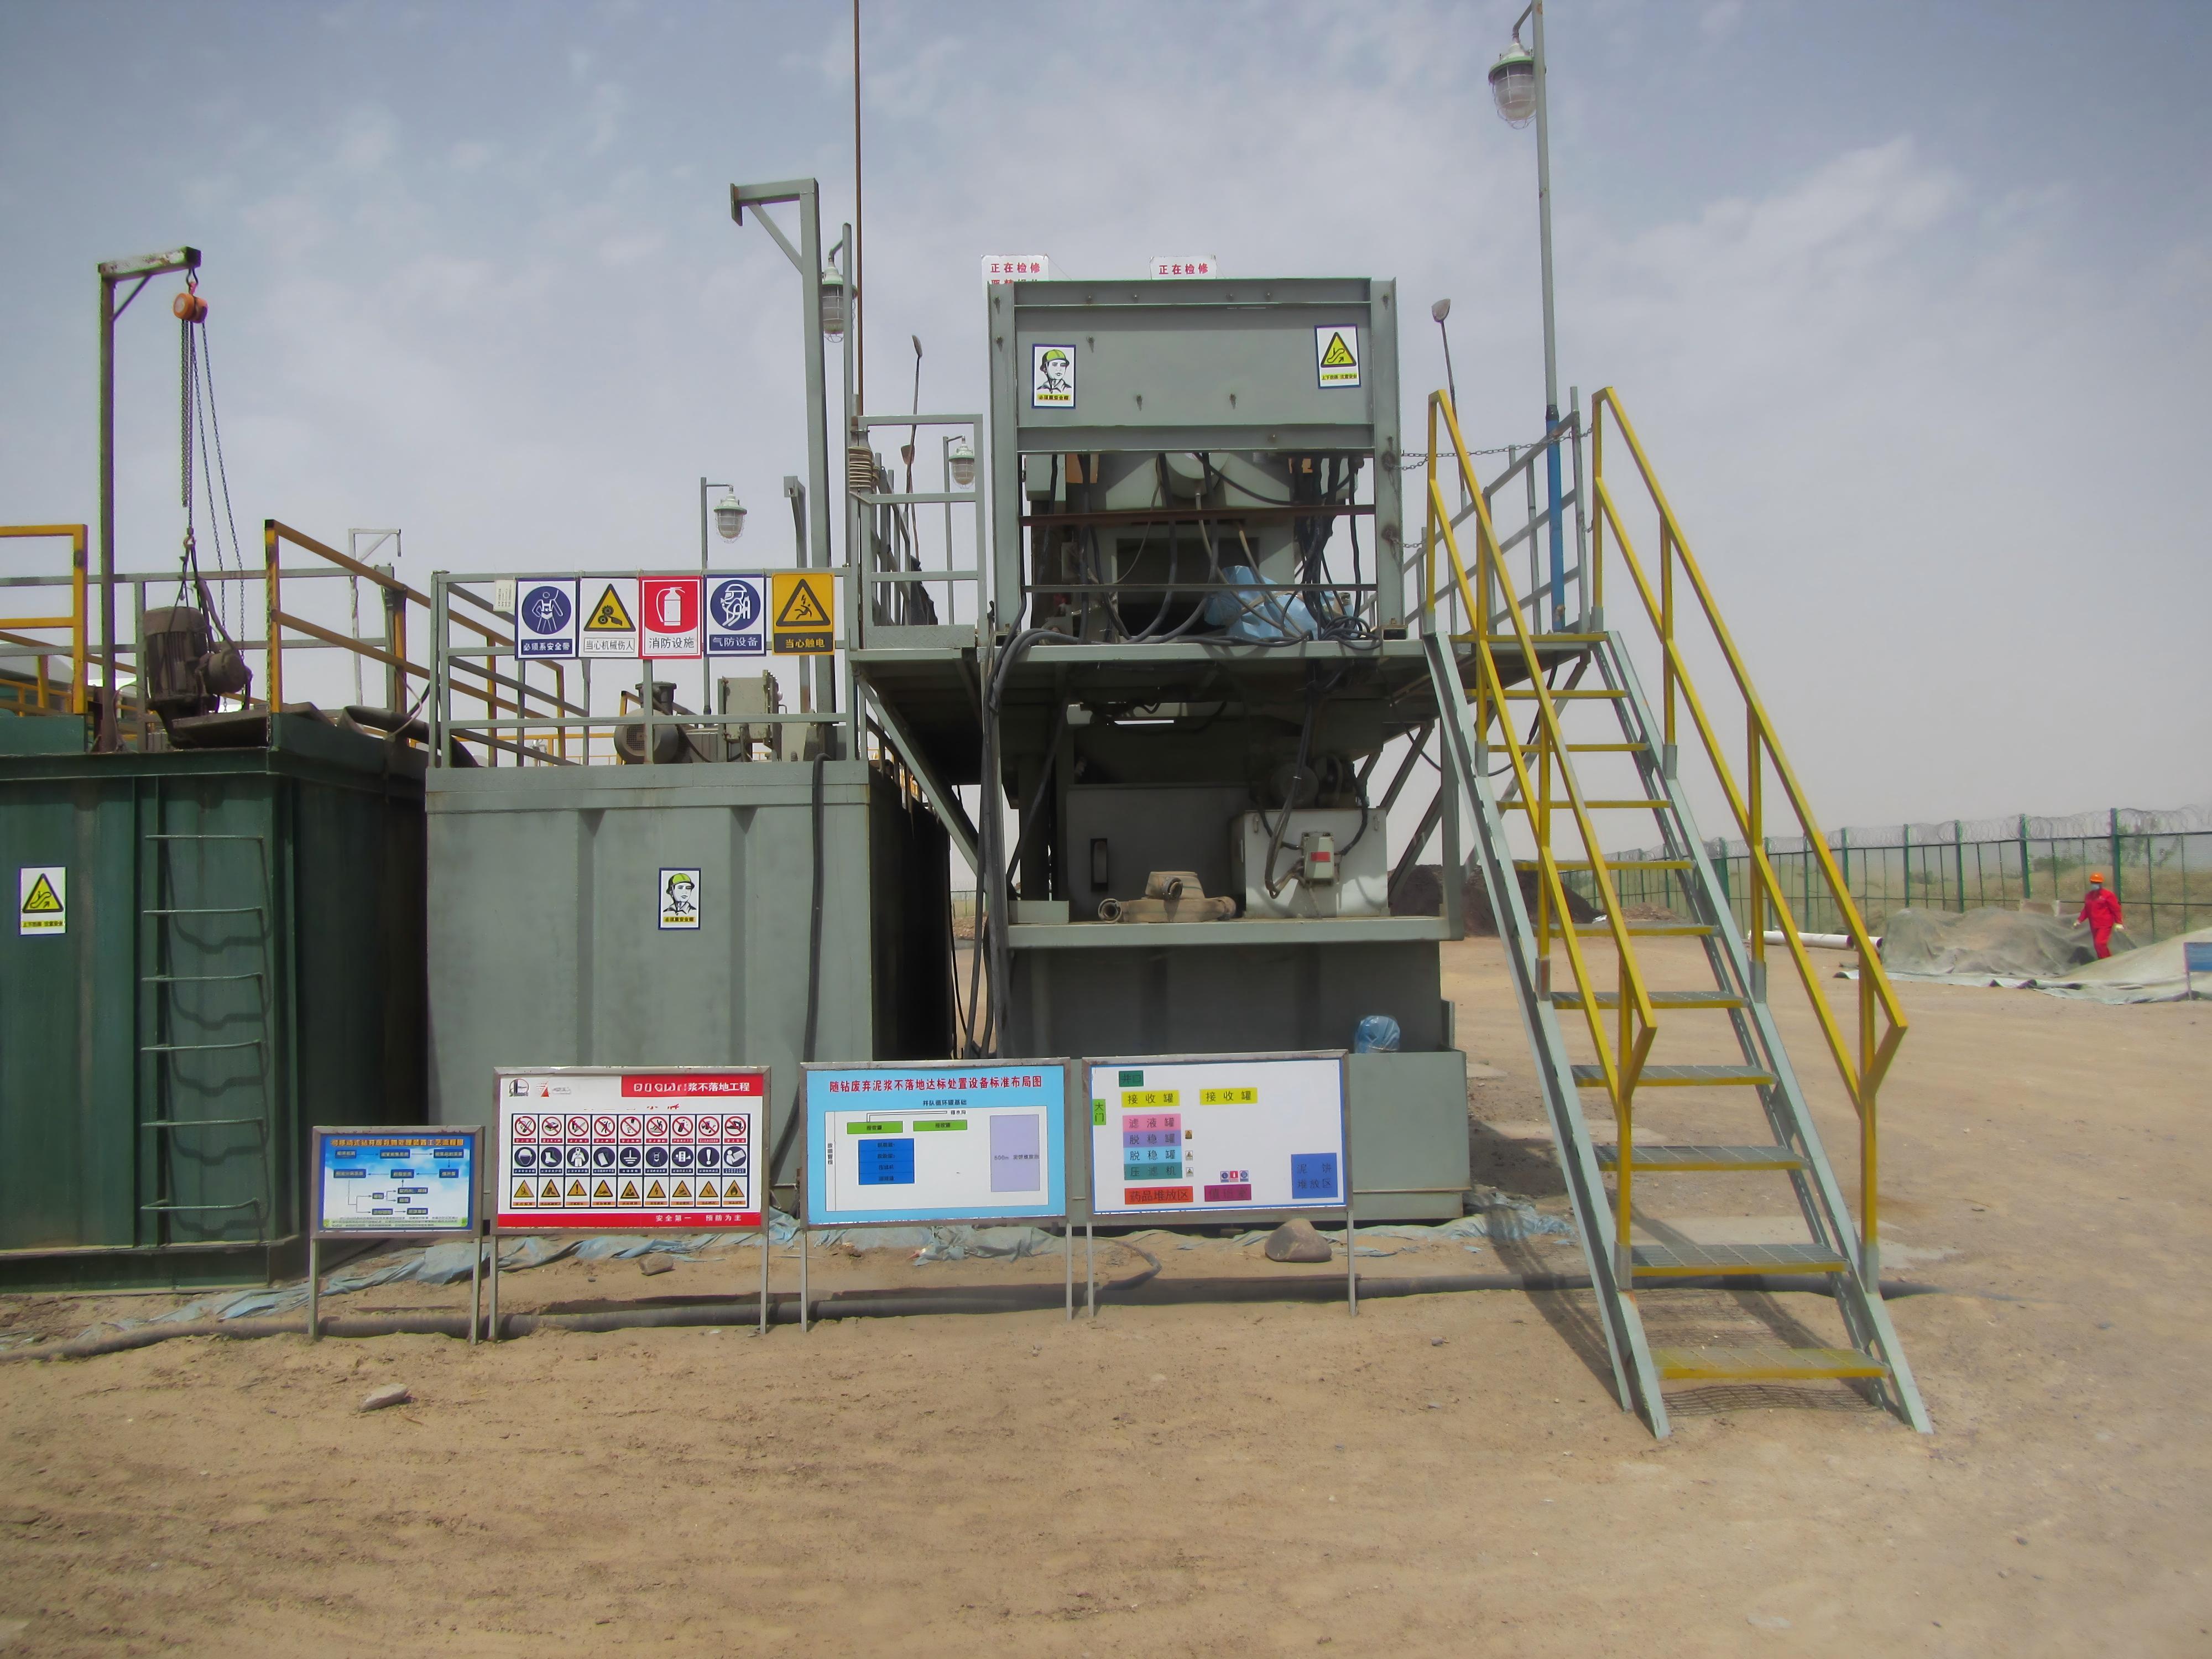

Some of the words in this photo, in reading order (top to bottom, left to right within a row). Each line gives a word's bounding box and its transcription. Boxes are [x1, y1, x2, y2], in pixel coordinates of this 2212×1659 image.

[990, 262, 1040, 273] 正在检修
[1159, 263, 1208, 275] 正在检修
[523, 642, 570, 651] 必须系安全带
[585, 640, 634, 651] 当心机械伤人
[649, 637, 695, 649] 消防设施
[712, 637, 759, 647] 气防设备
[785, 638, 825, 649] 当心触电
[1121, 1073, 1142, 1084] 井口
[830, 1076, 1042, 1093] 随钻废弃泥浆不落地达标处置设备标准布局图
[1128, 1093, 1173, 1104] 接收罐
[1206, 1091, 1251, 1102] 接收罐
[1094, 1102, 1104, 1122] 大门
[1130, 1150, 1176, 1161] 脱稳罐
